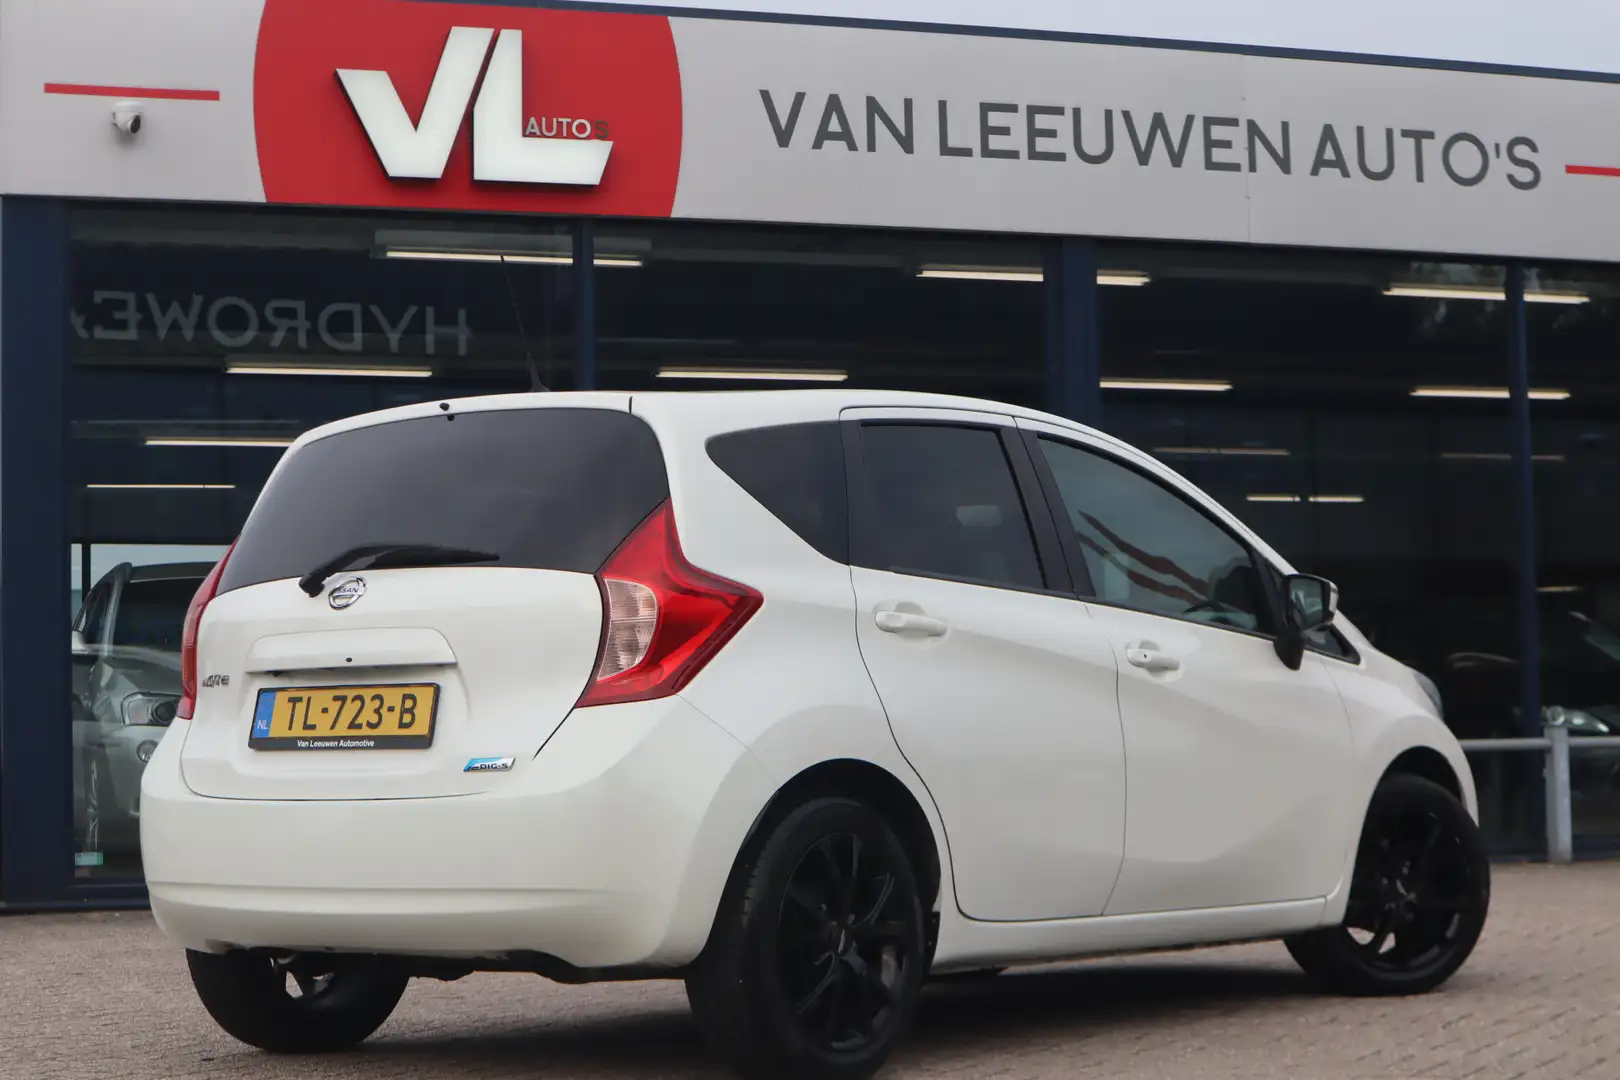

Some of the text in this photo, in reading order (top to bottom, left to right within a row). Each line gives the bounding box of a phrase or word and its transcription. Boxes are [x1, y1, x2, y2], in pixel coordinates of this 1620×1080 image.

[758, 89, 1542, 191] VAN LEEUWEN AUTO'S
[287, 693, 418, 731] TL-723-B
[257, 719, 268, 730] NL
[297, 739, 375, 748] Van Leeuwen Automotive
